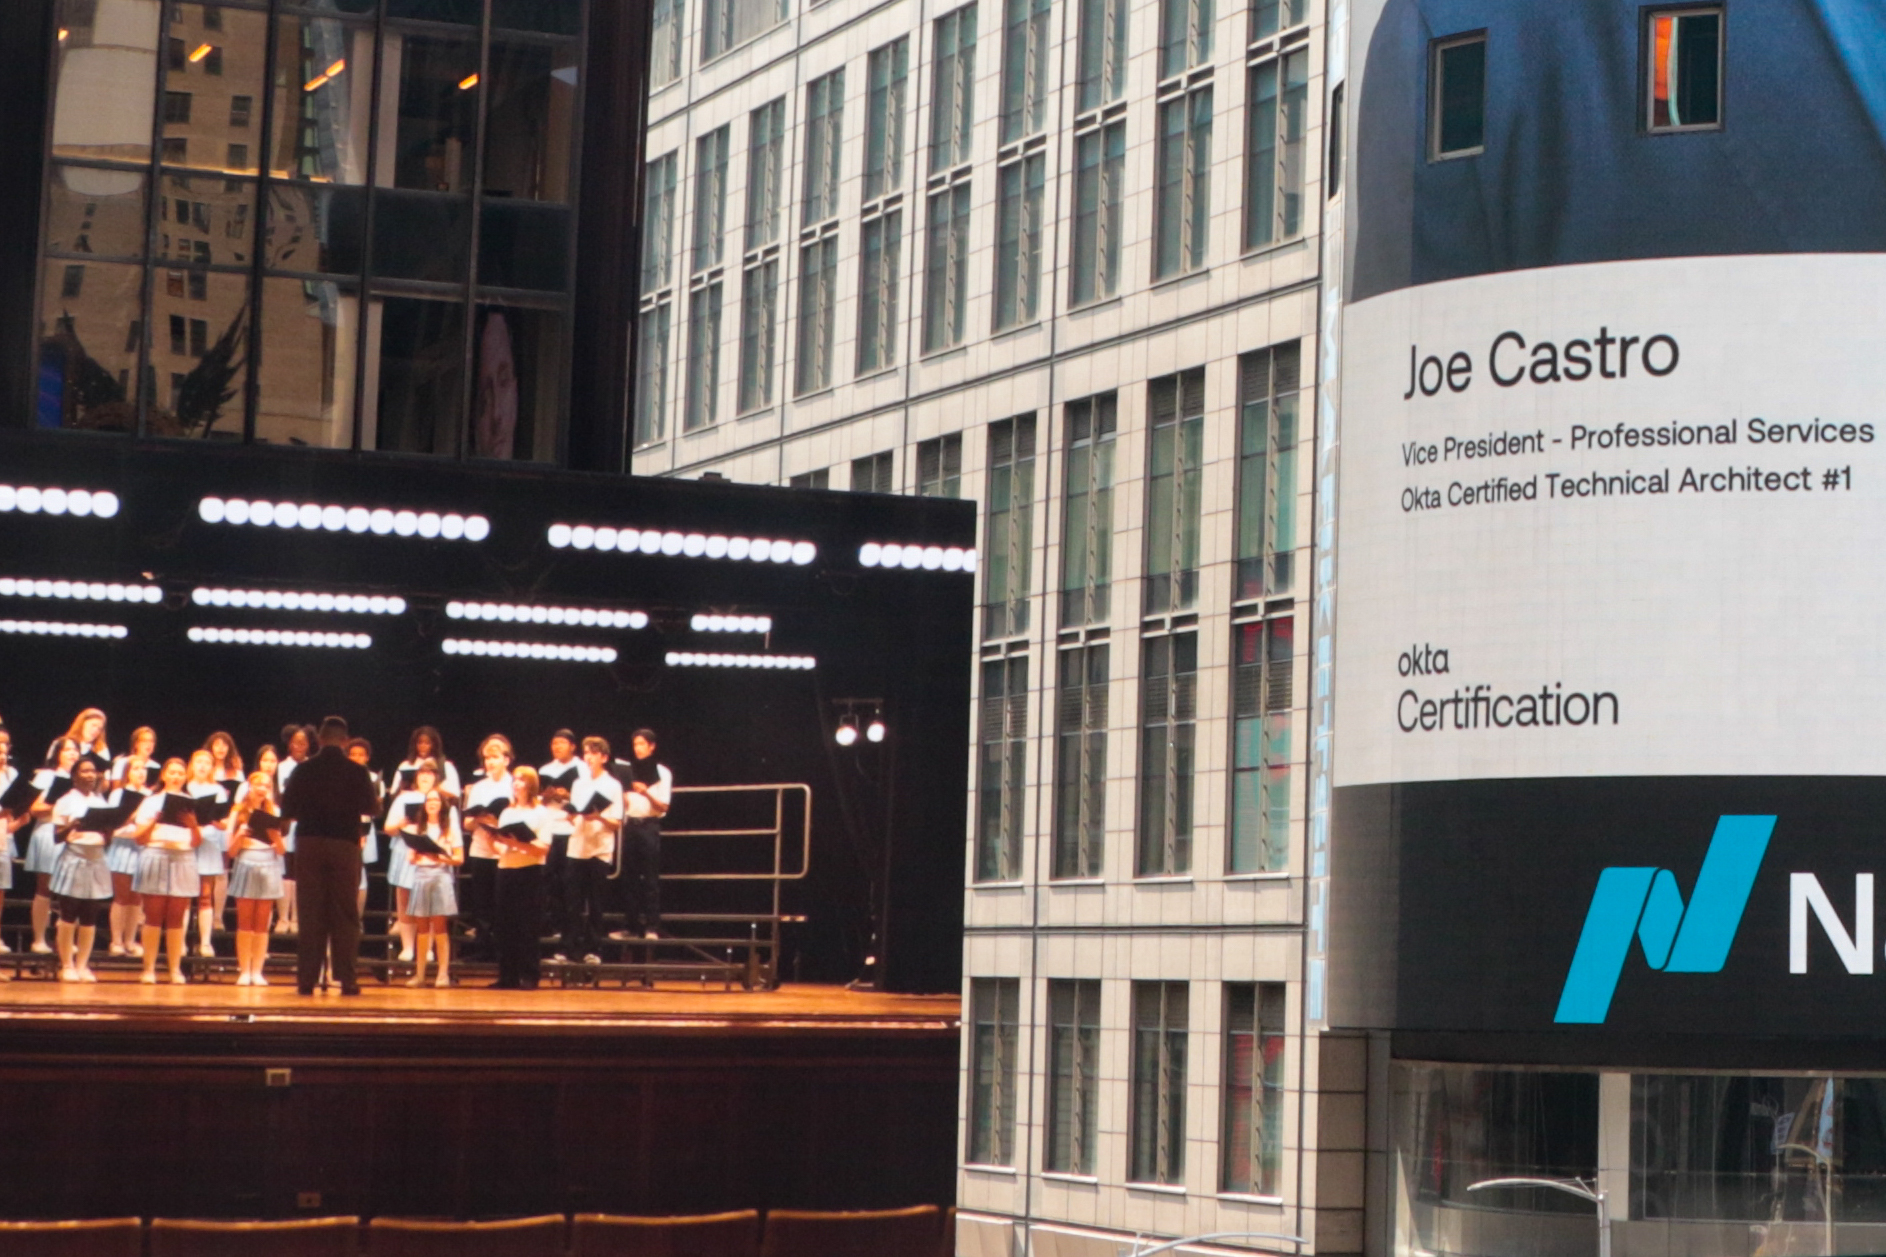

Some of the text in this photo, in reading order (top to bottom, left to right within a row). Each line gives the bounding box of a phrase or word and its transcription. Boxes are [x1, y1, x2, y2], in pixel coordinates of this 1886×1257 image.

[1403, 326, 1680, 400] Joe Castro
[1401, 442, 1438, 467] Vice
[1444, 429, 1544, 462] President
[1571, 418, 1737, 450] Professional
[1747, 417, 1875, 444] Services
[1400, 465, 1852, 513] Okta Certified Technical Architect #1
[1309, 286, 1338, 1024] MARKETSITE
[1398, 643, 1450, 677] okta
[1398, 681, 1619, 733] Certification
